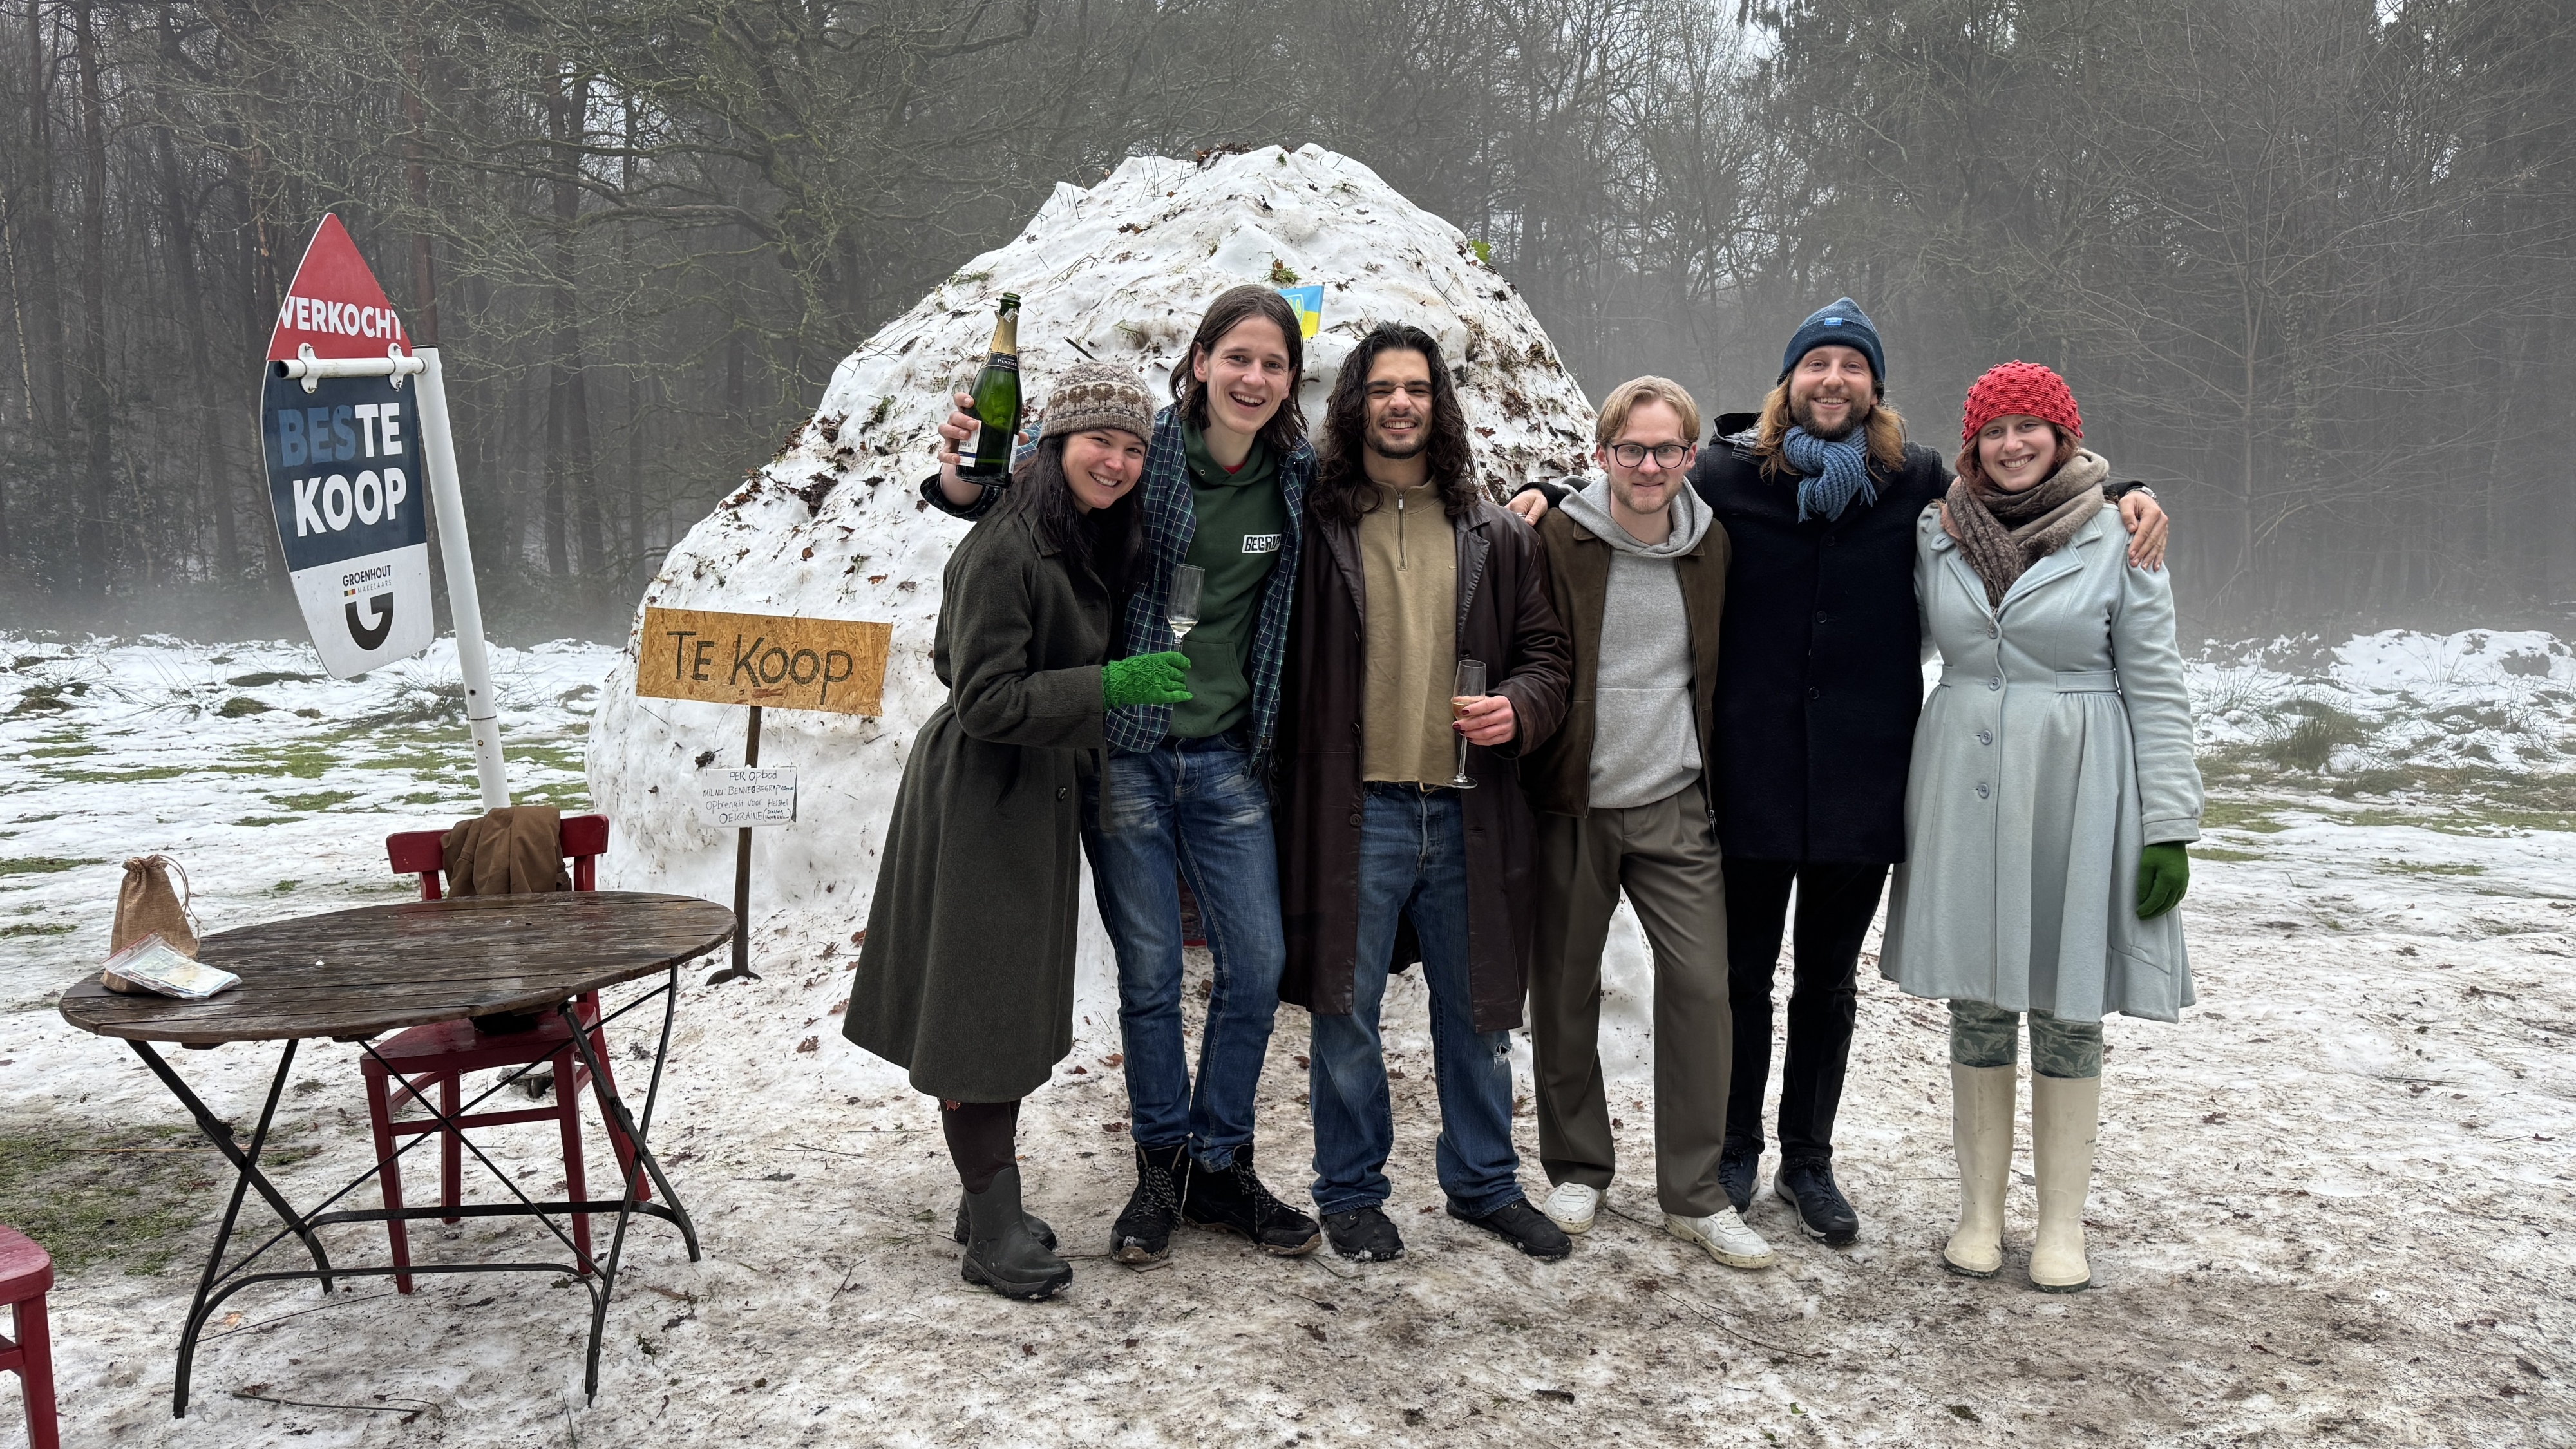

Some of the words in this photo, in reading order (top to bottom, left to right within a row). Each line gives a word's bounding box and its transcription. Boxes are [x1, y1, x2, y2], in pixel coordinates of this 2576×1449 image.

[281, 296, 401, 341] VERKOCHT
[278, 402, 402, 467] BESTE
[293, 468, 406, 537] KOOP
[1244, 536, 1281, 551] BEGRIP
[343, 565, 391, 587] GROENHOUT
[357, 579, 392, 594] MAKELAARS
[345, 591, 394, 650] G
[667, 631, 714, 681] TE
[730, 634, 853, 705] KOOP
[729, 771, 746, 781] PER
[749, 769, 777, 784] Opbod
